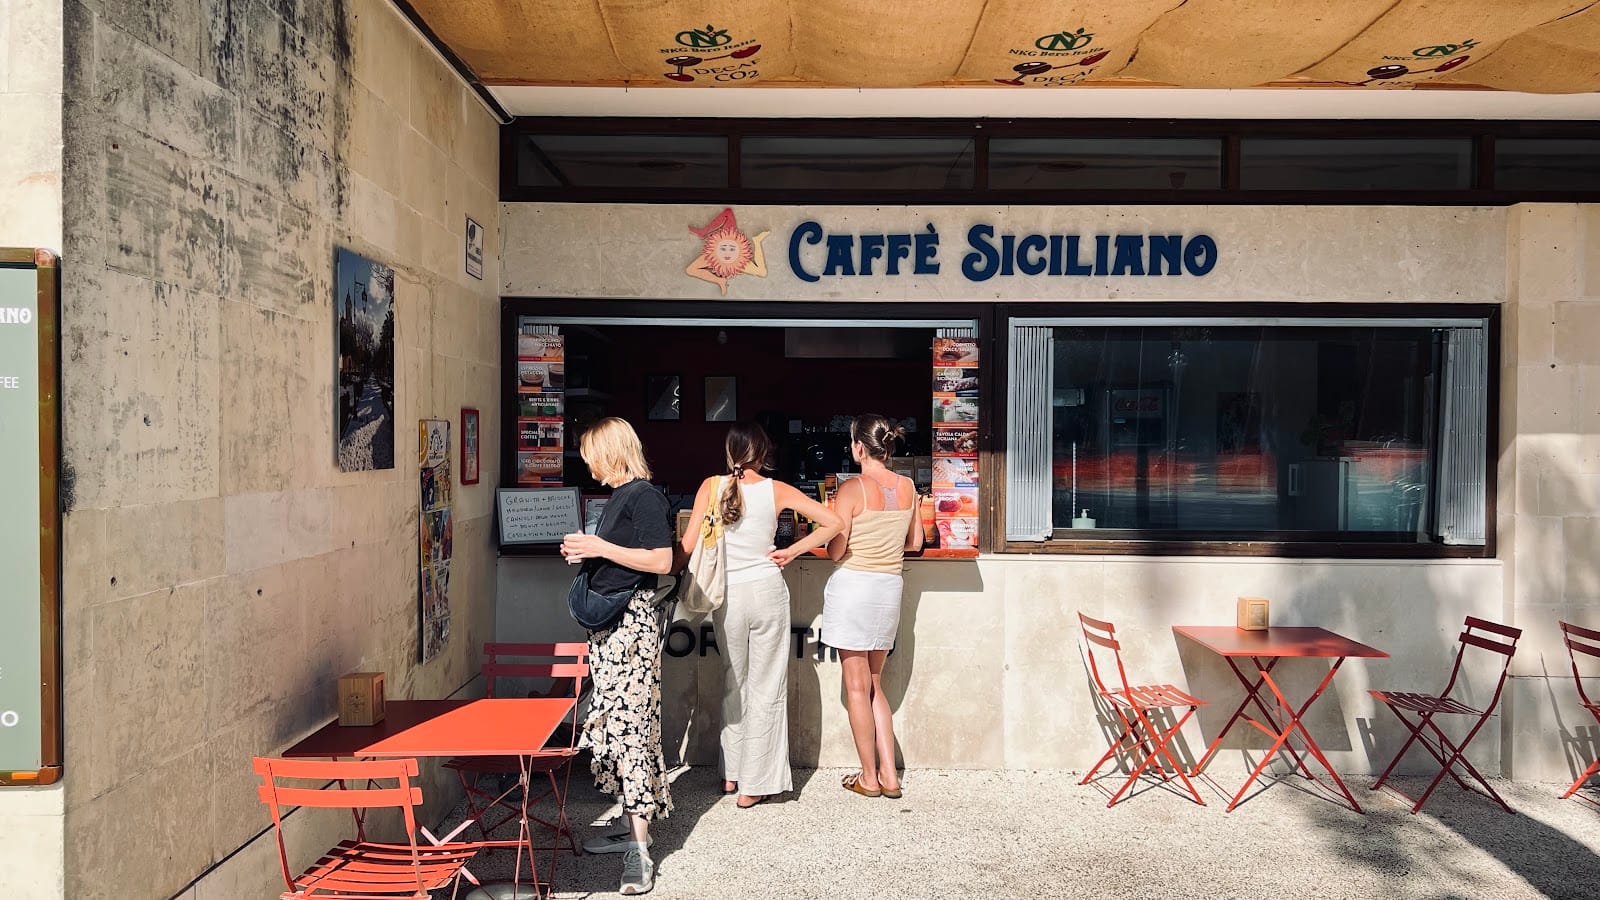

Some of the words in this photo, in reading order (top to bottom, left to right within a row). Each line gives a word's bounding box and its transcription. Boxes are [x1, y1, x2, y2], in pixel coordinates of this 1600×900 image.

[724, 39, 756, 50] Italia
[1008, 48, 1038, 57] NKG
[1072, 47, 1104, 56] Italia
[715, 69, 760, 82] CO2
[788, 221, 940, 283] CAFFÈ
[961, 223, 1218, 283] SICILIANO
